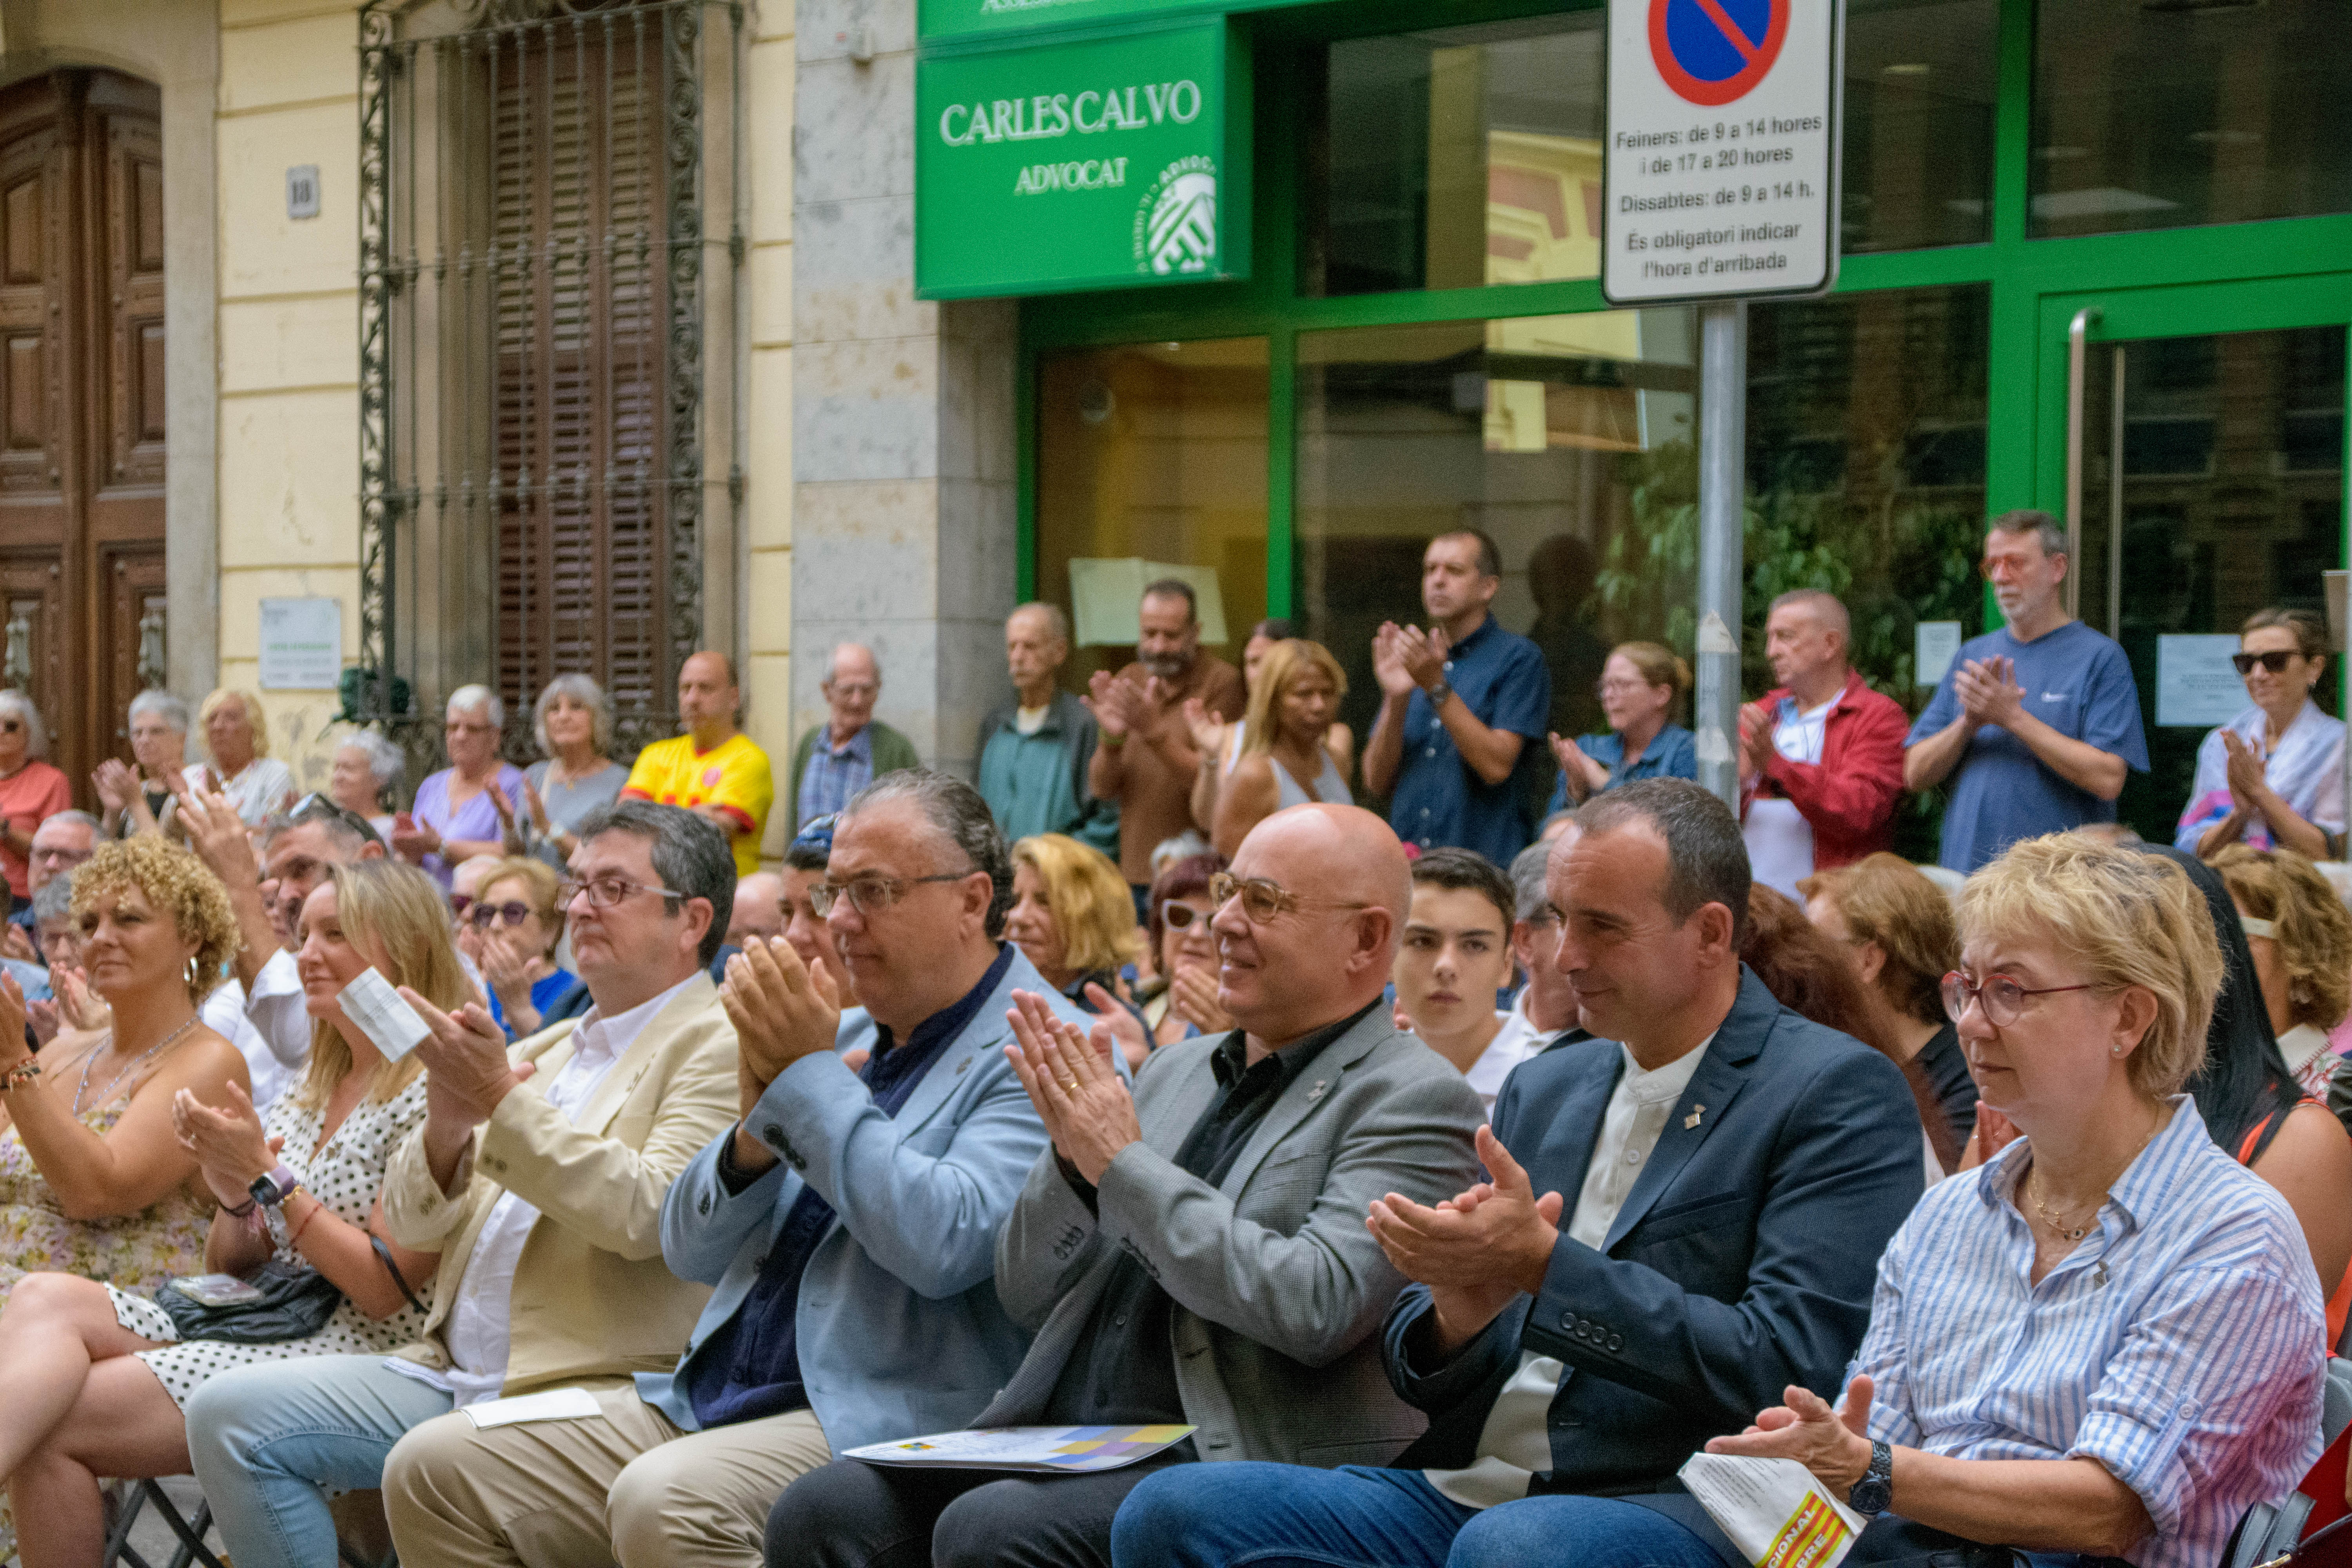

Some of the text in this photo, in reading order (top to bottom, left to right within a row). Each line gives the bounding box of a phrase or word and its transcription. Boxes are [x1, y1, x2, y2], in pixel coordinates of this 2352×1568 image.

[941, 80, 1201, 146] CARLES CALVO
[1616, 114, 1823, 149] Feiners: de 9 a 14 hores
[1015, 157, 1129, 194] ADVOCAT
[1640, 146, 1793, 174] i de 17 a 20 hores
[1621, 180, 1814, 213] Dissabtes: de 9 a 14 h.
[1628, 222, 1802, 251] És obligatori indicar
[1643, 253, 1787, 278] l'hora d'arribada
